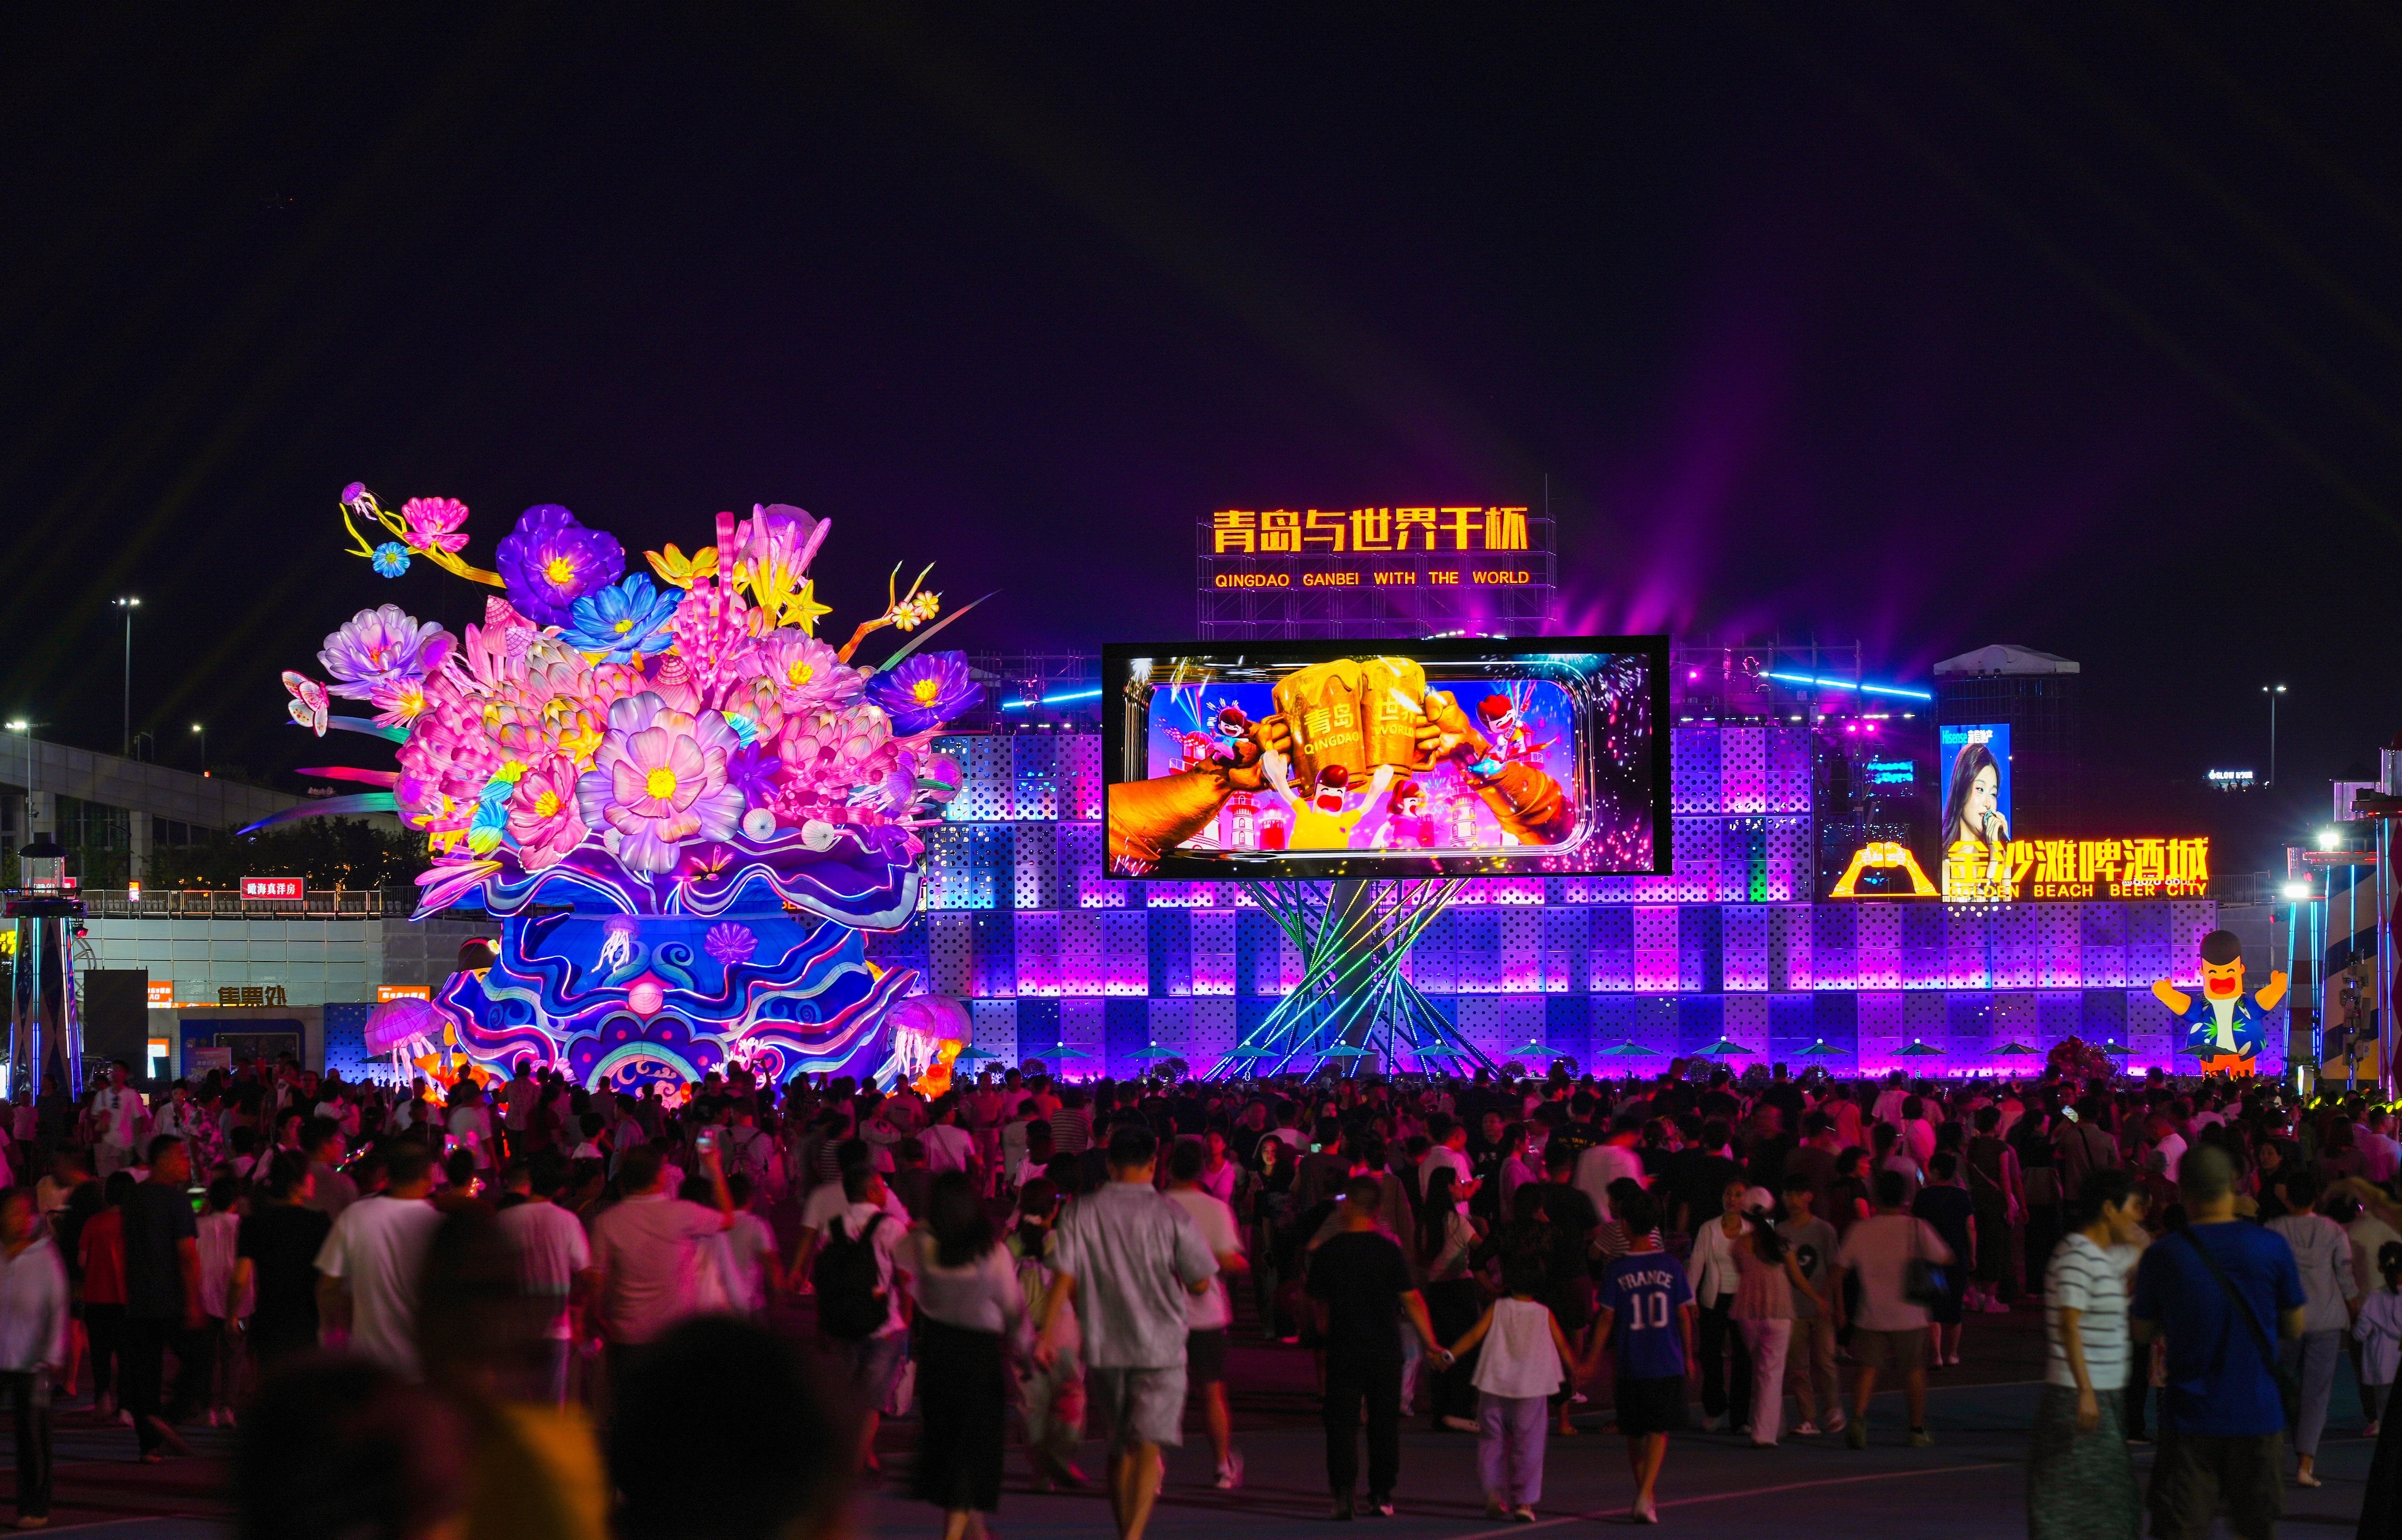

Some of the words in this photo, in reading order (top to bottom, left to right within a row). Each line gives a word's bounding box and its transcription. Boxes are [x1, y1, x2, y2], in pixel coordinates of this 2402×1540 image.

[1214, 507, 1528, 552] 青岛与世界干杯
[1215, 574, 1289, 588] QINGDAO
[1303, 573, 1359, 586] GANBEI
[1374, 572, 1415, 585] WITH
[1429, 571, 1459, 584] THE
[1473, 571, 1529, 584] WORLD
[1304, 703, 1354, 738] 青岛
[1374, 723, 1414, 738] WORLD
[1304, 731, 1359, 755] QINGDAO
[1942, 730, 1967, 744] Hisense
[1947, 837, 2209, 883] 金沙滩啤酒城
[1948, 885, 2020, 898] GOLDEN
[2034, 884, 2093, 898] BEACH
[2109, 884, 2155, 897] BEER
[2166, 883, 2207, 897] CITY
[217, 985, 288, 1008] 售票处
[1617, 1269, 1674, 1291] FRANCE
[1628, 1291, 1669, 1331] 10
